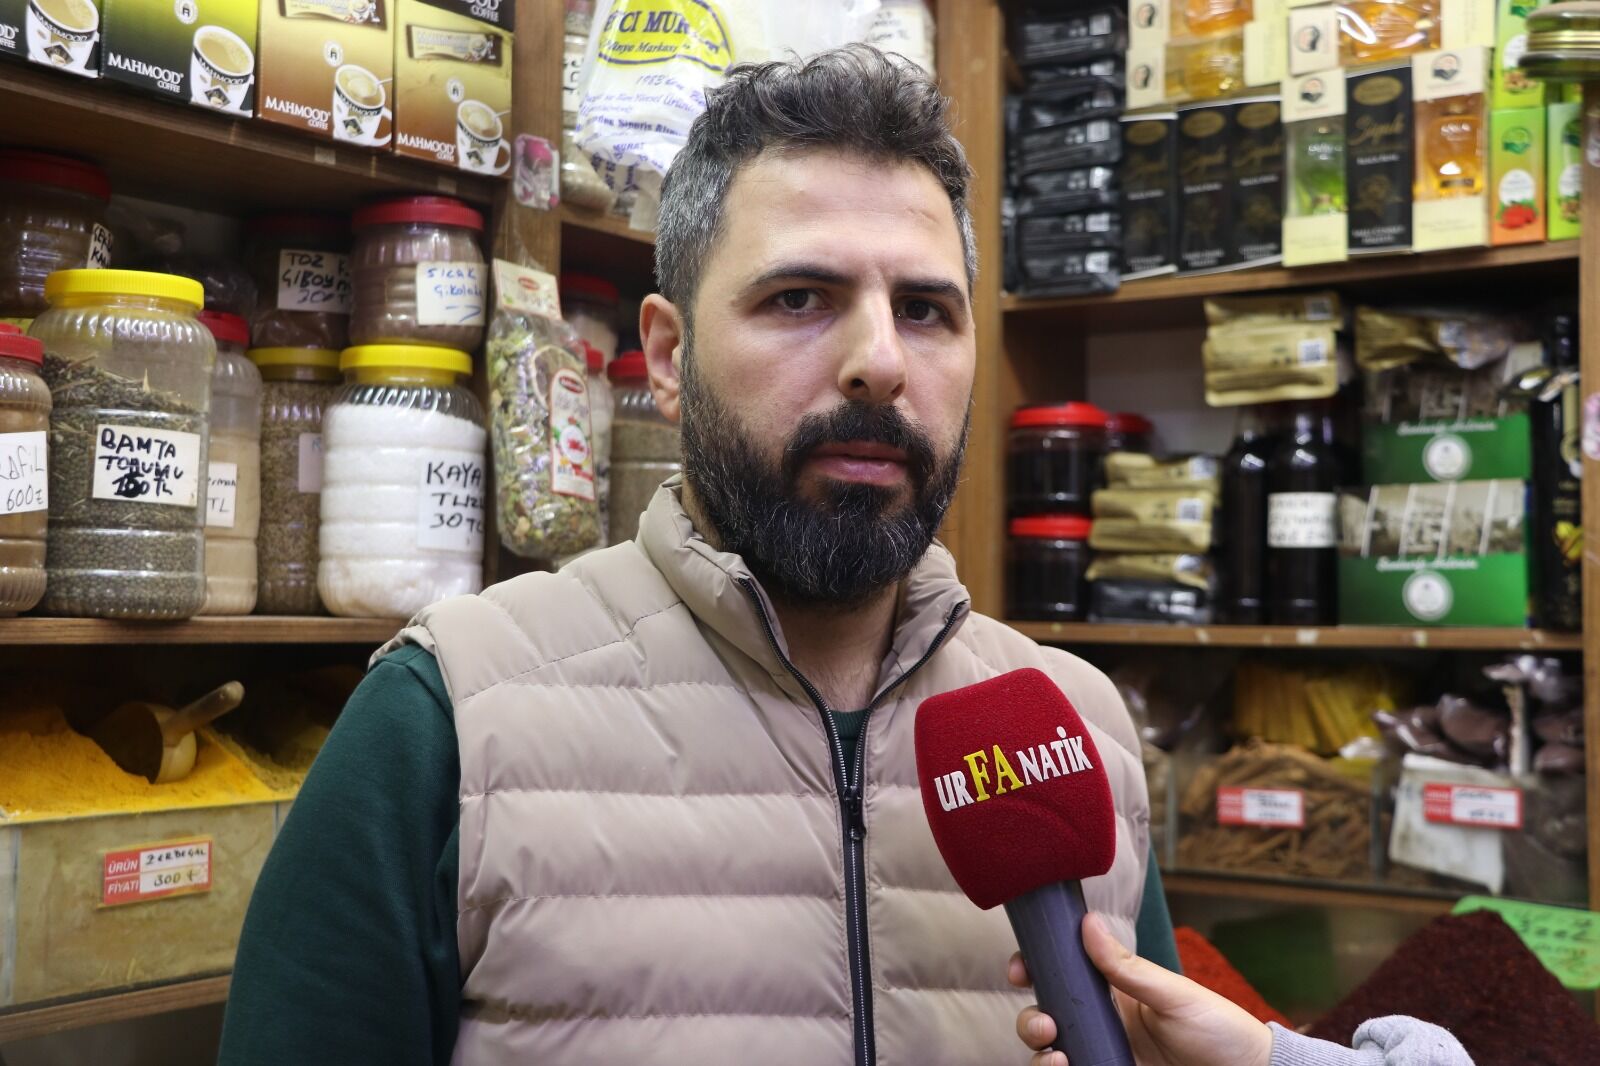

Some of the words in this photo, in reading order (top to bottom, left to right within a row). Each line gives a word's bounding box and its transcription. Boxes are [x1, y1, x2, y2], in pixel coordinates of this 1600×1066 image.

[107, 52, 181, 85] MAHMOOD
[157, 80, 181, 93] COFFEE
[265, 95, 329, 123] MAHMOOD
[307, 119, 329, 131] COFFEE
[396, 131, 455, 155] MAHMOOD
[426, 461, 483, 489] KAYA
[154, 477, 173, 498] TL
[207, 497, 230, 513] TL
[429, 512, 463, 529] 30
[108, 860, 138, 875] ÜRÜN
[108, 879, 139, 895] FİYATI
[154, 873, 181, 888] 300
